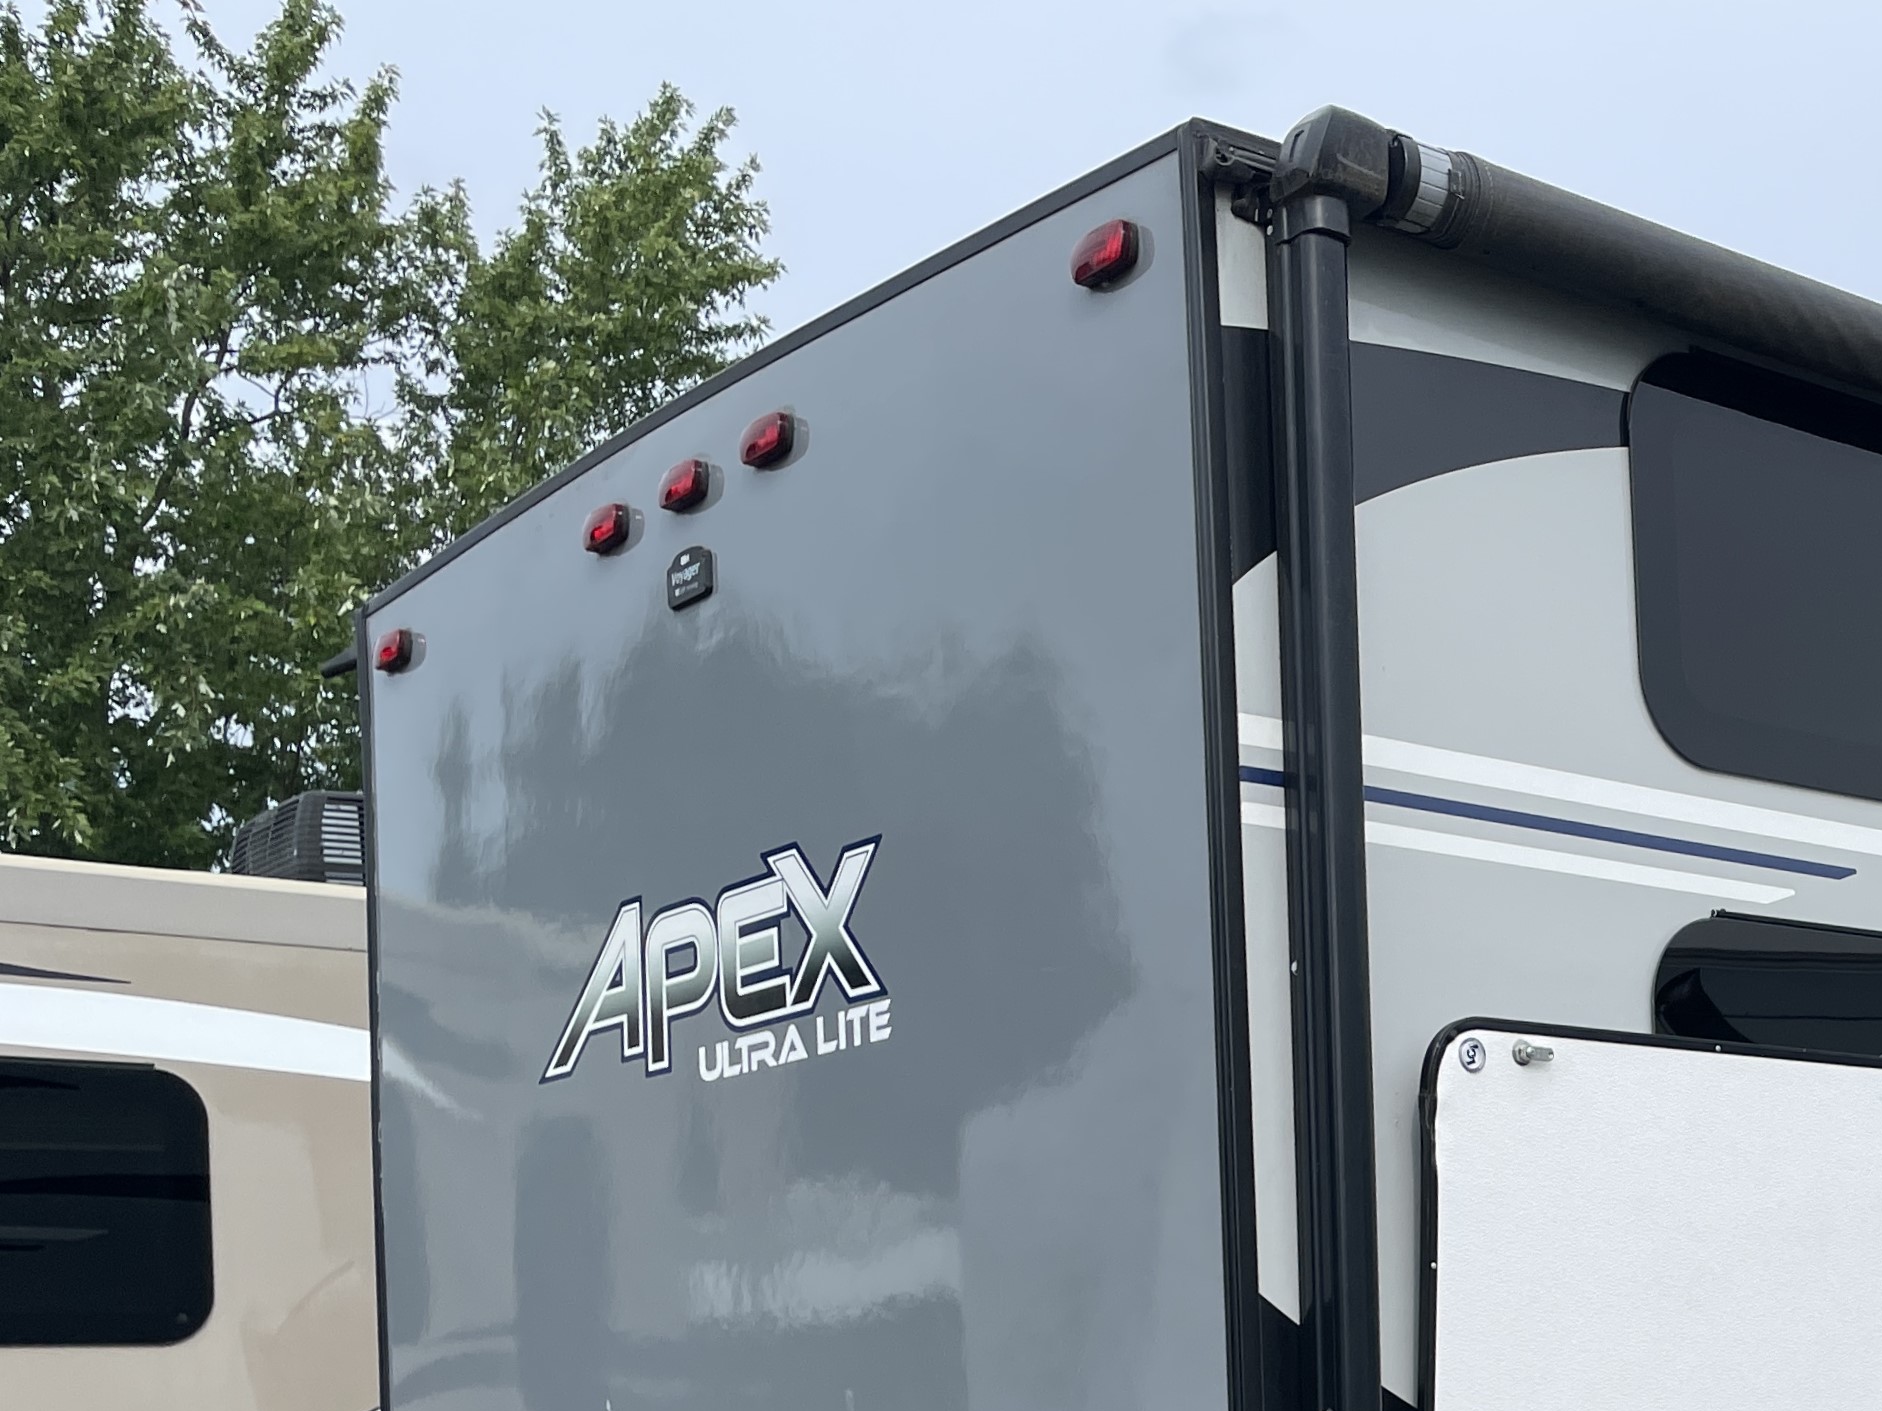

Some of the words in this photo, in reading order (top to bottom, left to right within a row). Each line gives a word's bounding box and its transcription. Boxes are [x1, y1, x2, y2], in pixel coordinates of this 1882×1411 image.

[671, 562, 700, 586] Voyager
[539, 834, 888, 1085] APEX
[698, 1023, 808, 1082] ULTRA
[816, 998, 892, 1056] LITE
